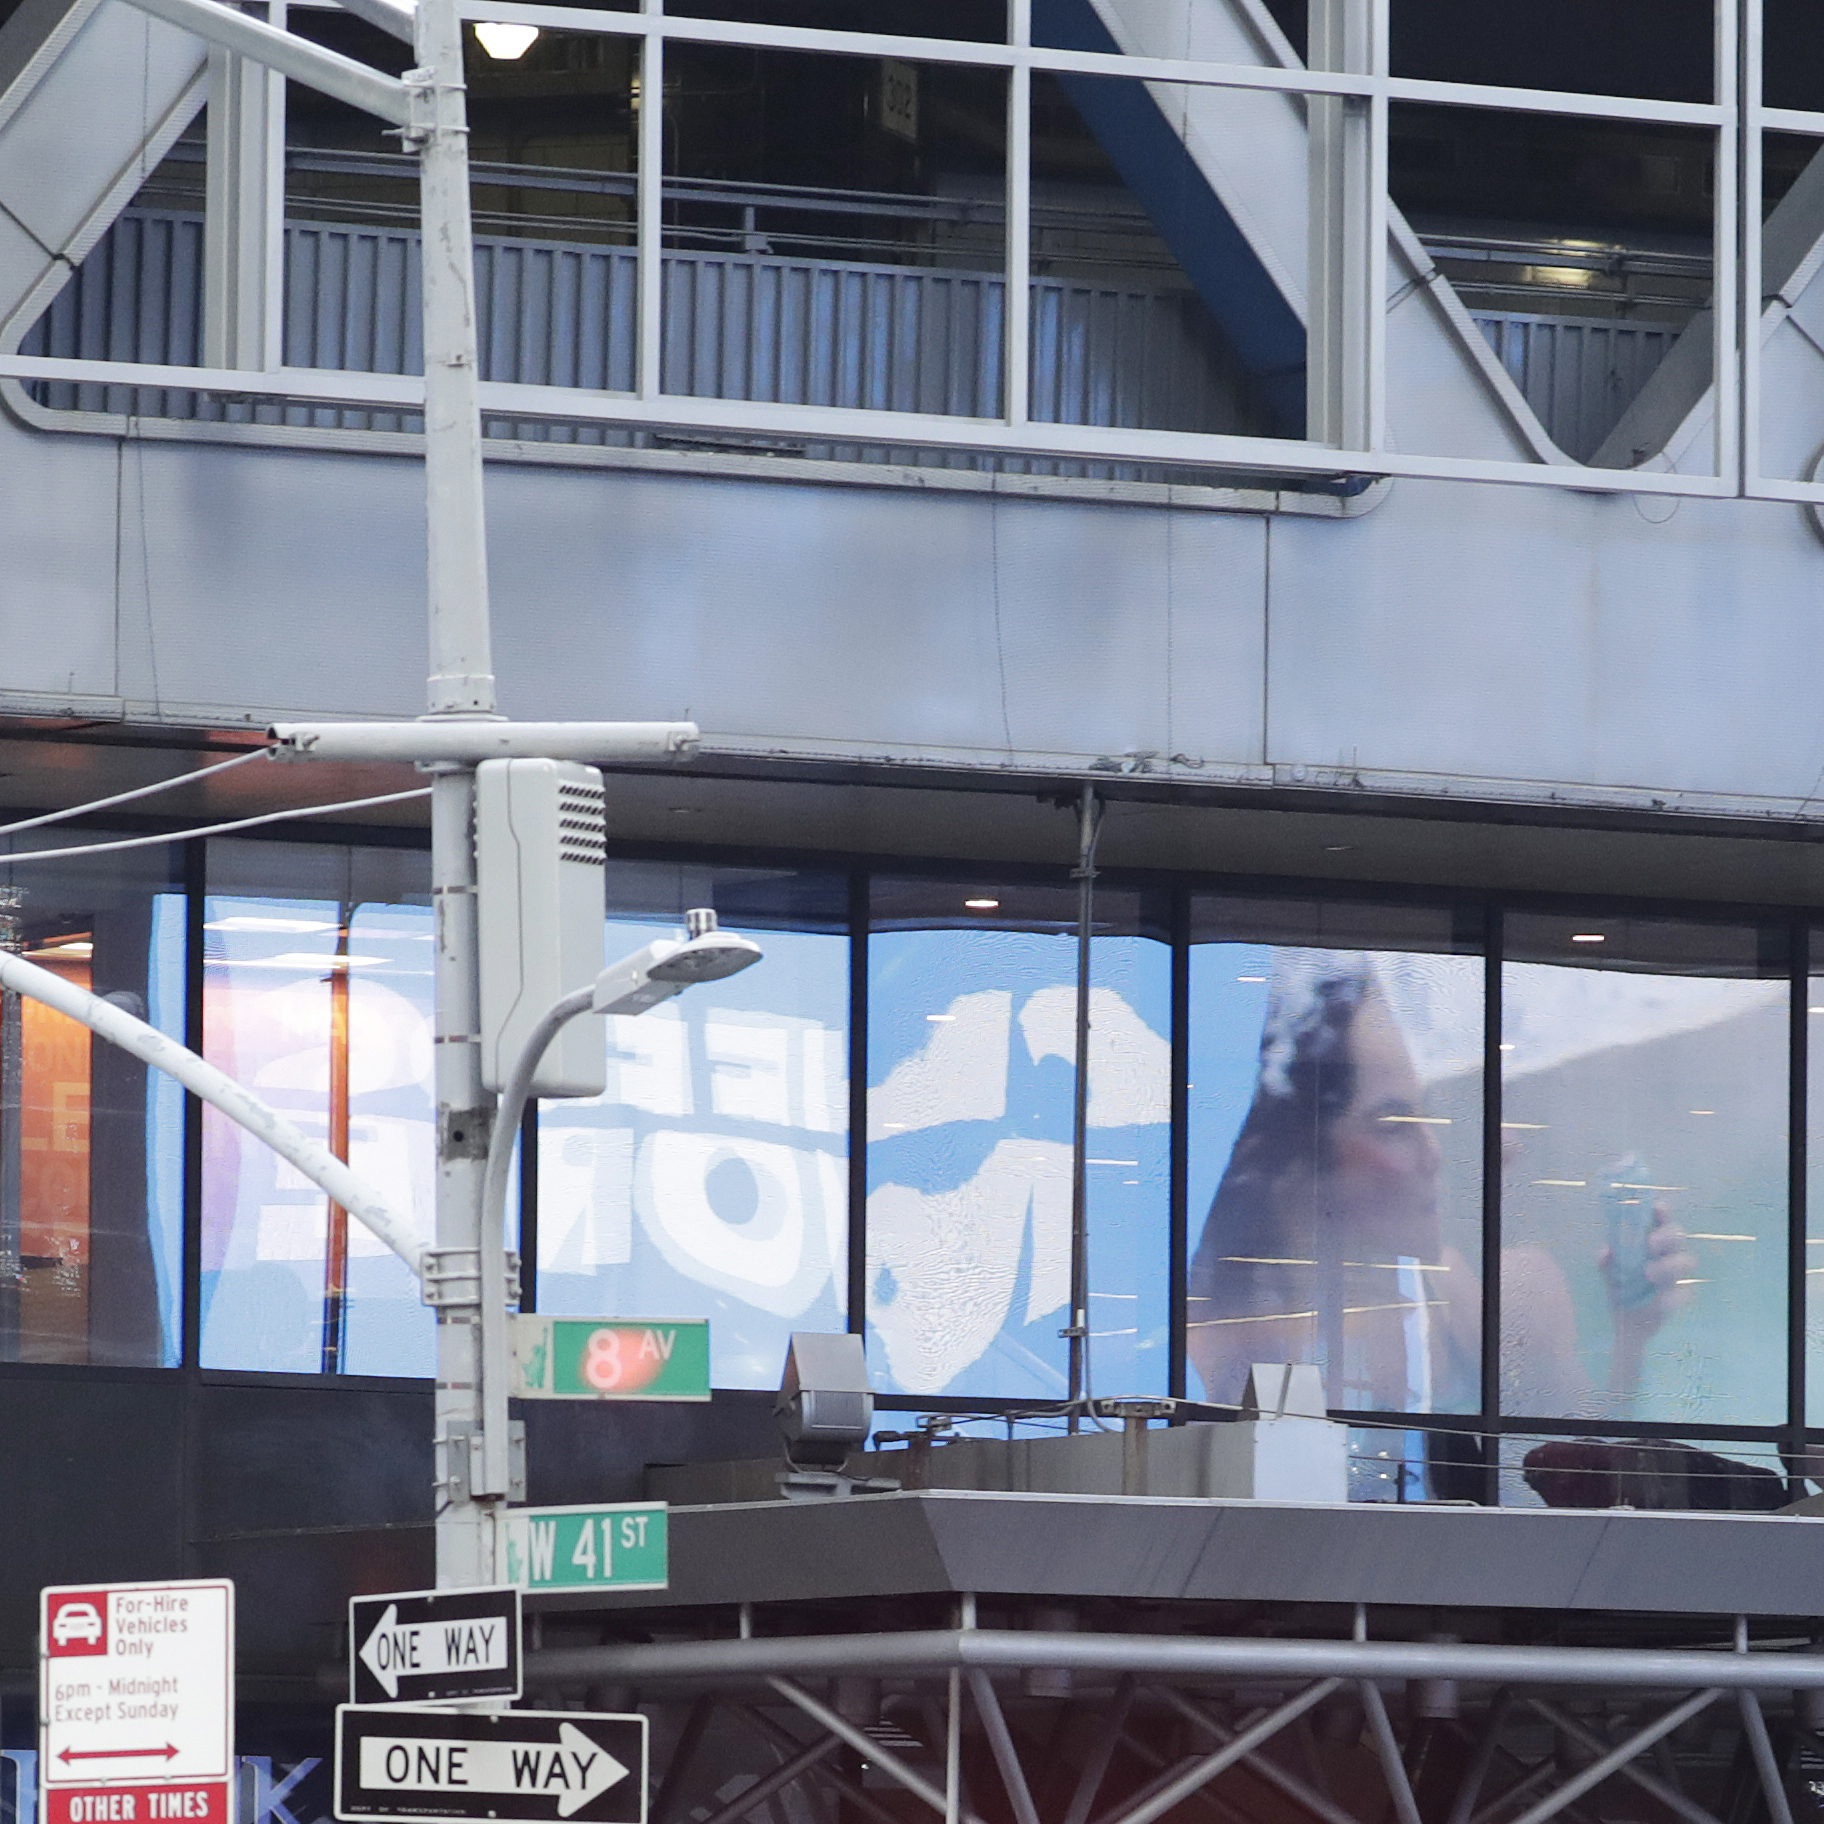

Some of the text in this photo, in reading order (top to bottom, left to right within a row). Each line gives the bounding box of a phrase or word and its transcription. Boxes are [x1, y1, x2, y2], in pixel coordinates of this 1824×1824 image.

[586, 1328, 676, 1388] 8 AV
[529, 1516, 649, 1581] W 41 ST
[116, 1596, 189, 1613] For-Hire
[116, 1617, 188, 1634] Vehicles
[116, 1639, 153, 1658] Only
[377, 1624, 496, 1670] ONE WAY
[55, 1682, 91, 1701] 6pm
[109, 1677, 178, 1698] Midnight
[55, 1702, 178, 1723] Except Sunday
[386, 1745, 598, 1790] ONE WAY
[69, 1791, 209, 1823] OTHER TIMES
